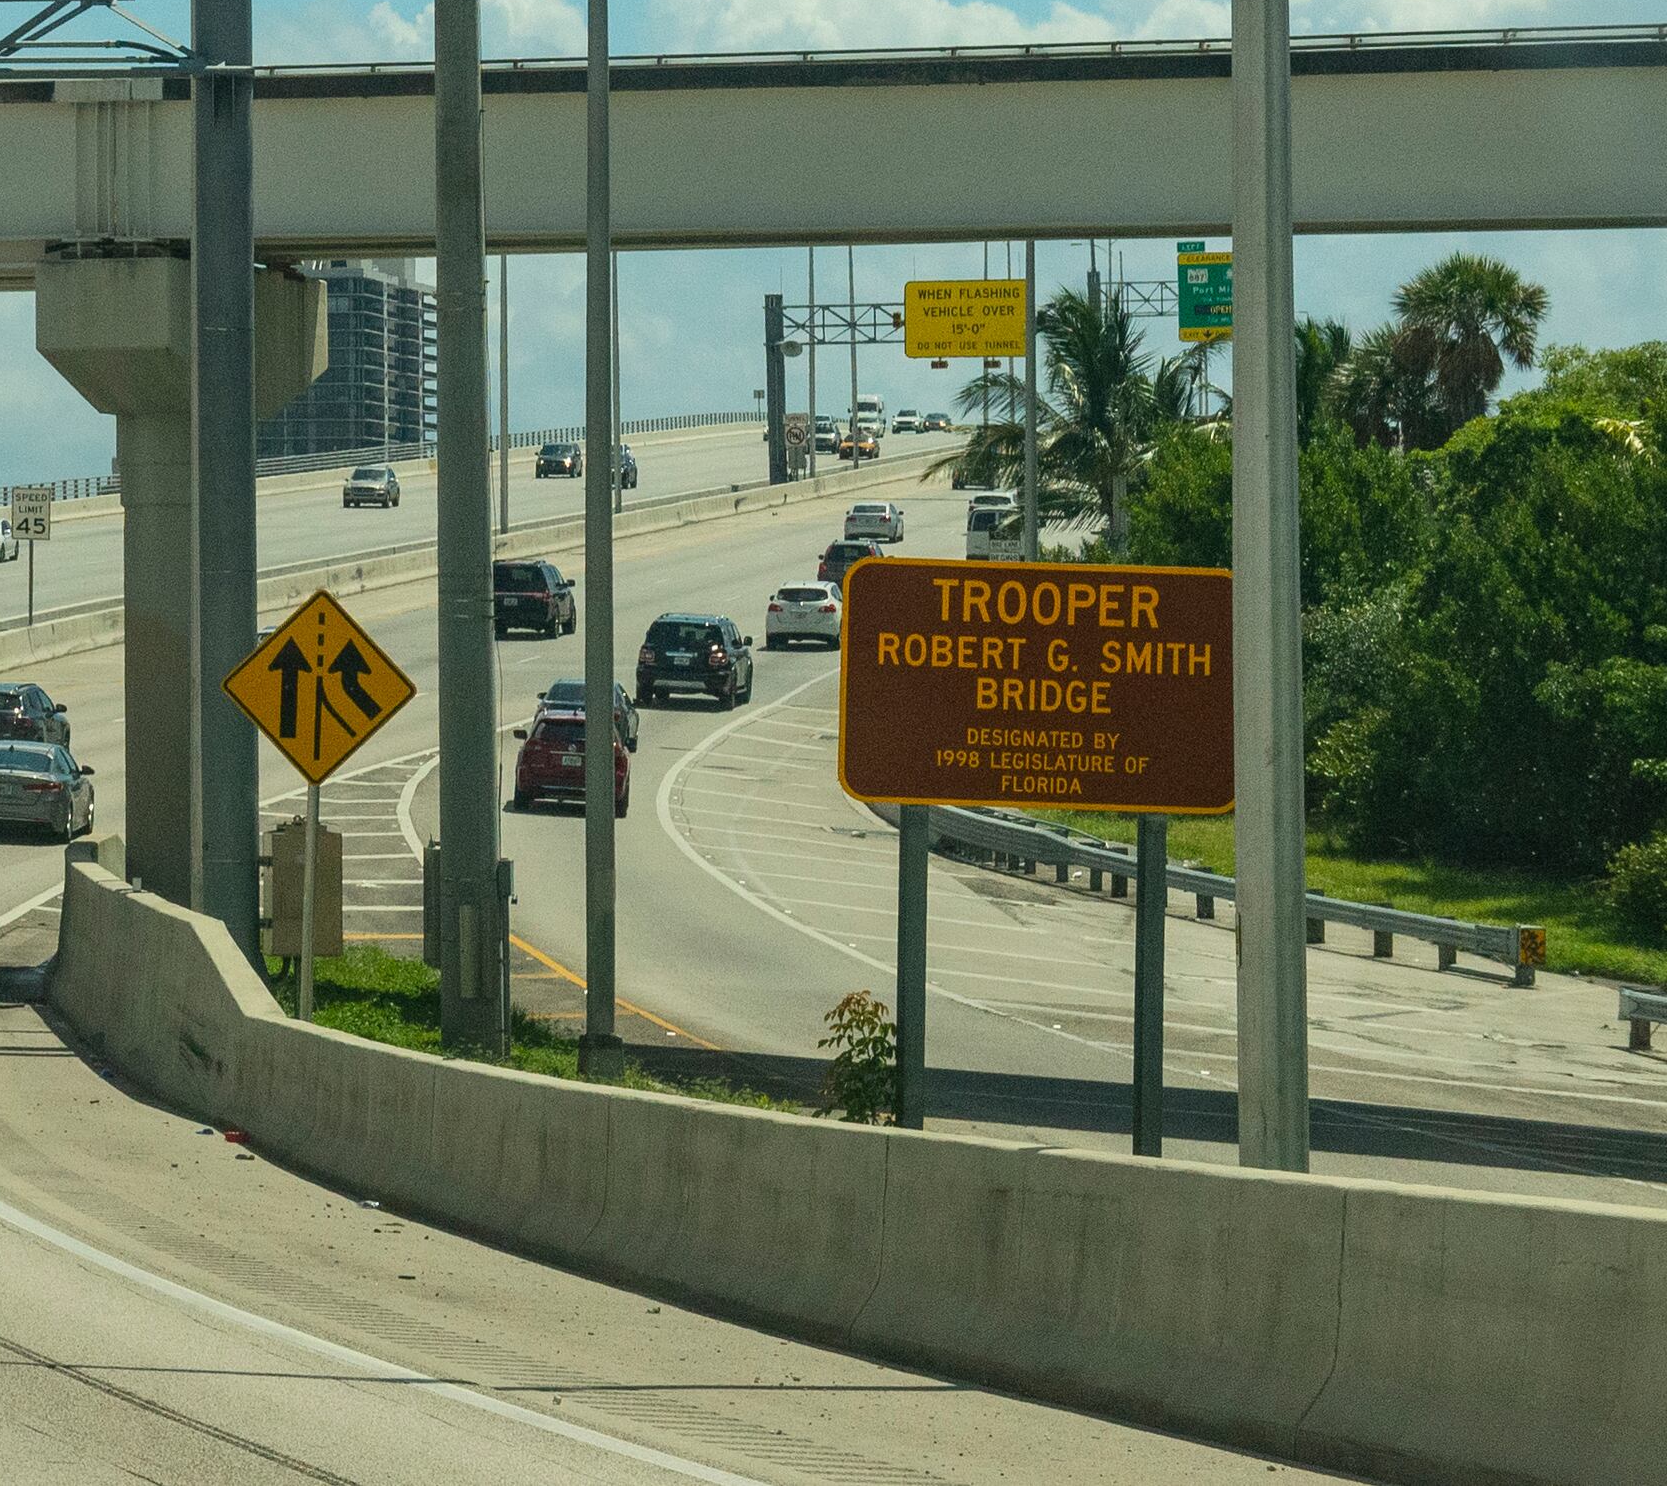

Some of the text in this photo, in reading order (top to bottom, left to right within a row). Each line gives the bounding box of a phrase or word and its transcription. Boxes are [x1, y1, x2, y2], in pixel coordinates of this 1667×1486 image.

[917, 287, 1020, 300] WHEN FLASHING
[923, 305, 1015, 318] VEHICLE OVER
[917, 340, 1021, 350] DO NOT USE TUNNEL
[15, 493, 47, 502] SPEED
[18, 505, 43, 514] LIMIT
[15, 517, 46, 535] 45
[932, 577, 1160, 630] TROOPER
[877, 631, 1212, 677] ROBERT G. SMITH
[976, 677, 1112, 715] BRIDGE
[966, 727, 1121, 751] DESIGNATED BY
[936, 749, 1150, 775] 1998 LEGISLATURE OF
[1001, 774, 1083, 795] FLORIDA
